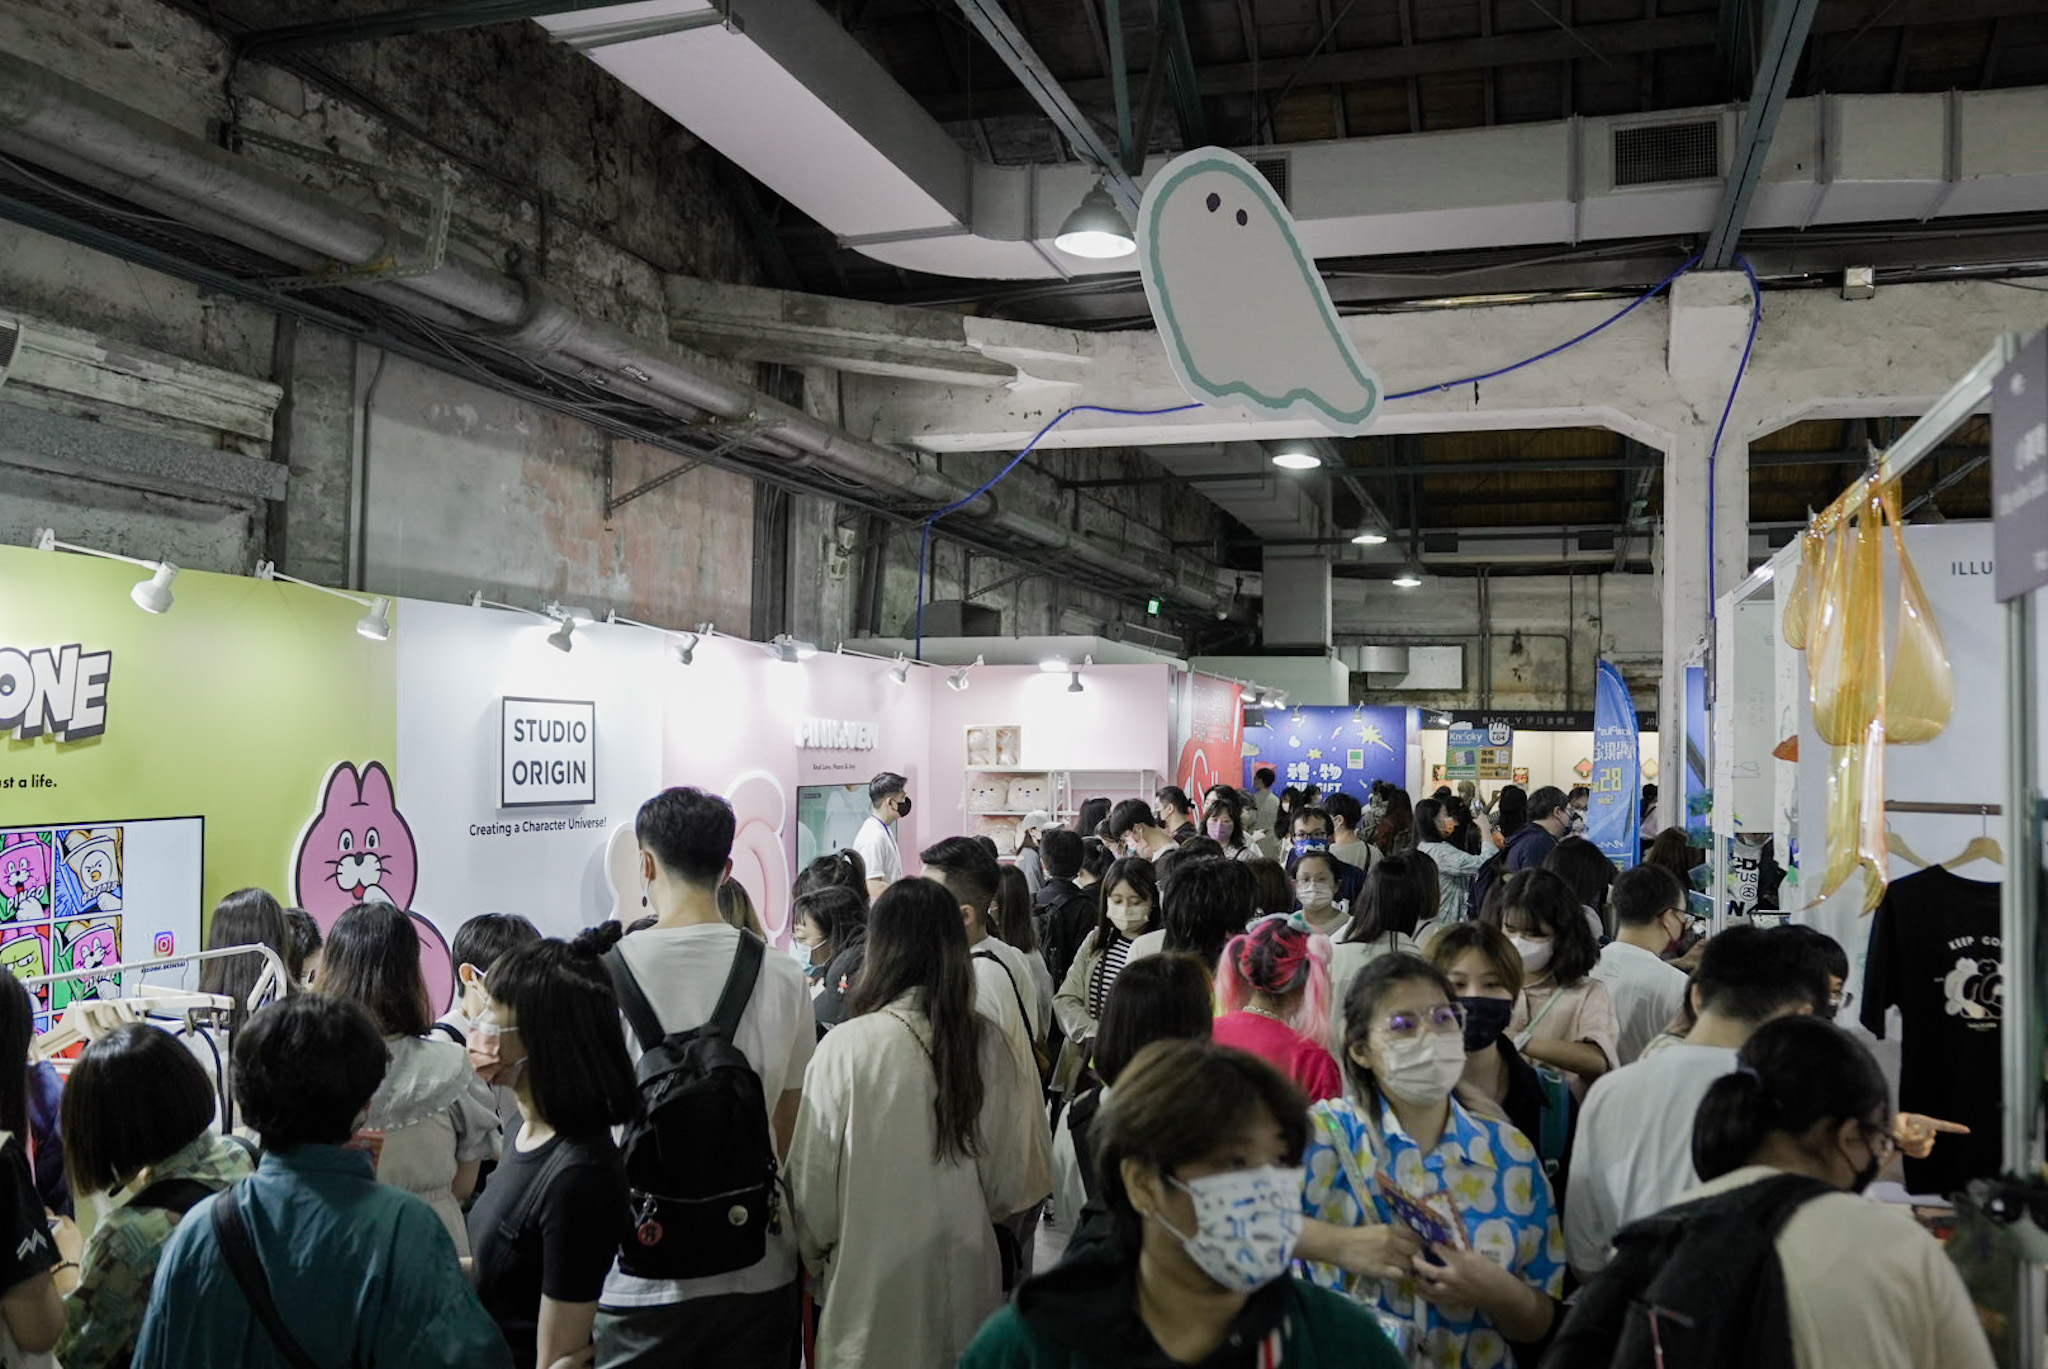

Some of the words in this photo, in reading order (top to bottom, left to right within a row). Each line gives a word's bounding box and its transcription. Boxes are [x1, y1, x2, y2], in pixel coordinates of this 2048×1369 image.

[514, 718, 587, 743] STUDIO
[0, 776, 14, 788] st
[19, 778, 27, 788] a
[31, 773, 57, 788] life.
[512, 760, 586, 785] ORIGIN
[469, 821, 512, 837] Creating
[514, 823, 520, 833] a
[522, 820, 566, 833] Character
[568, 816, 607, 830] Universe!
